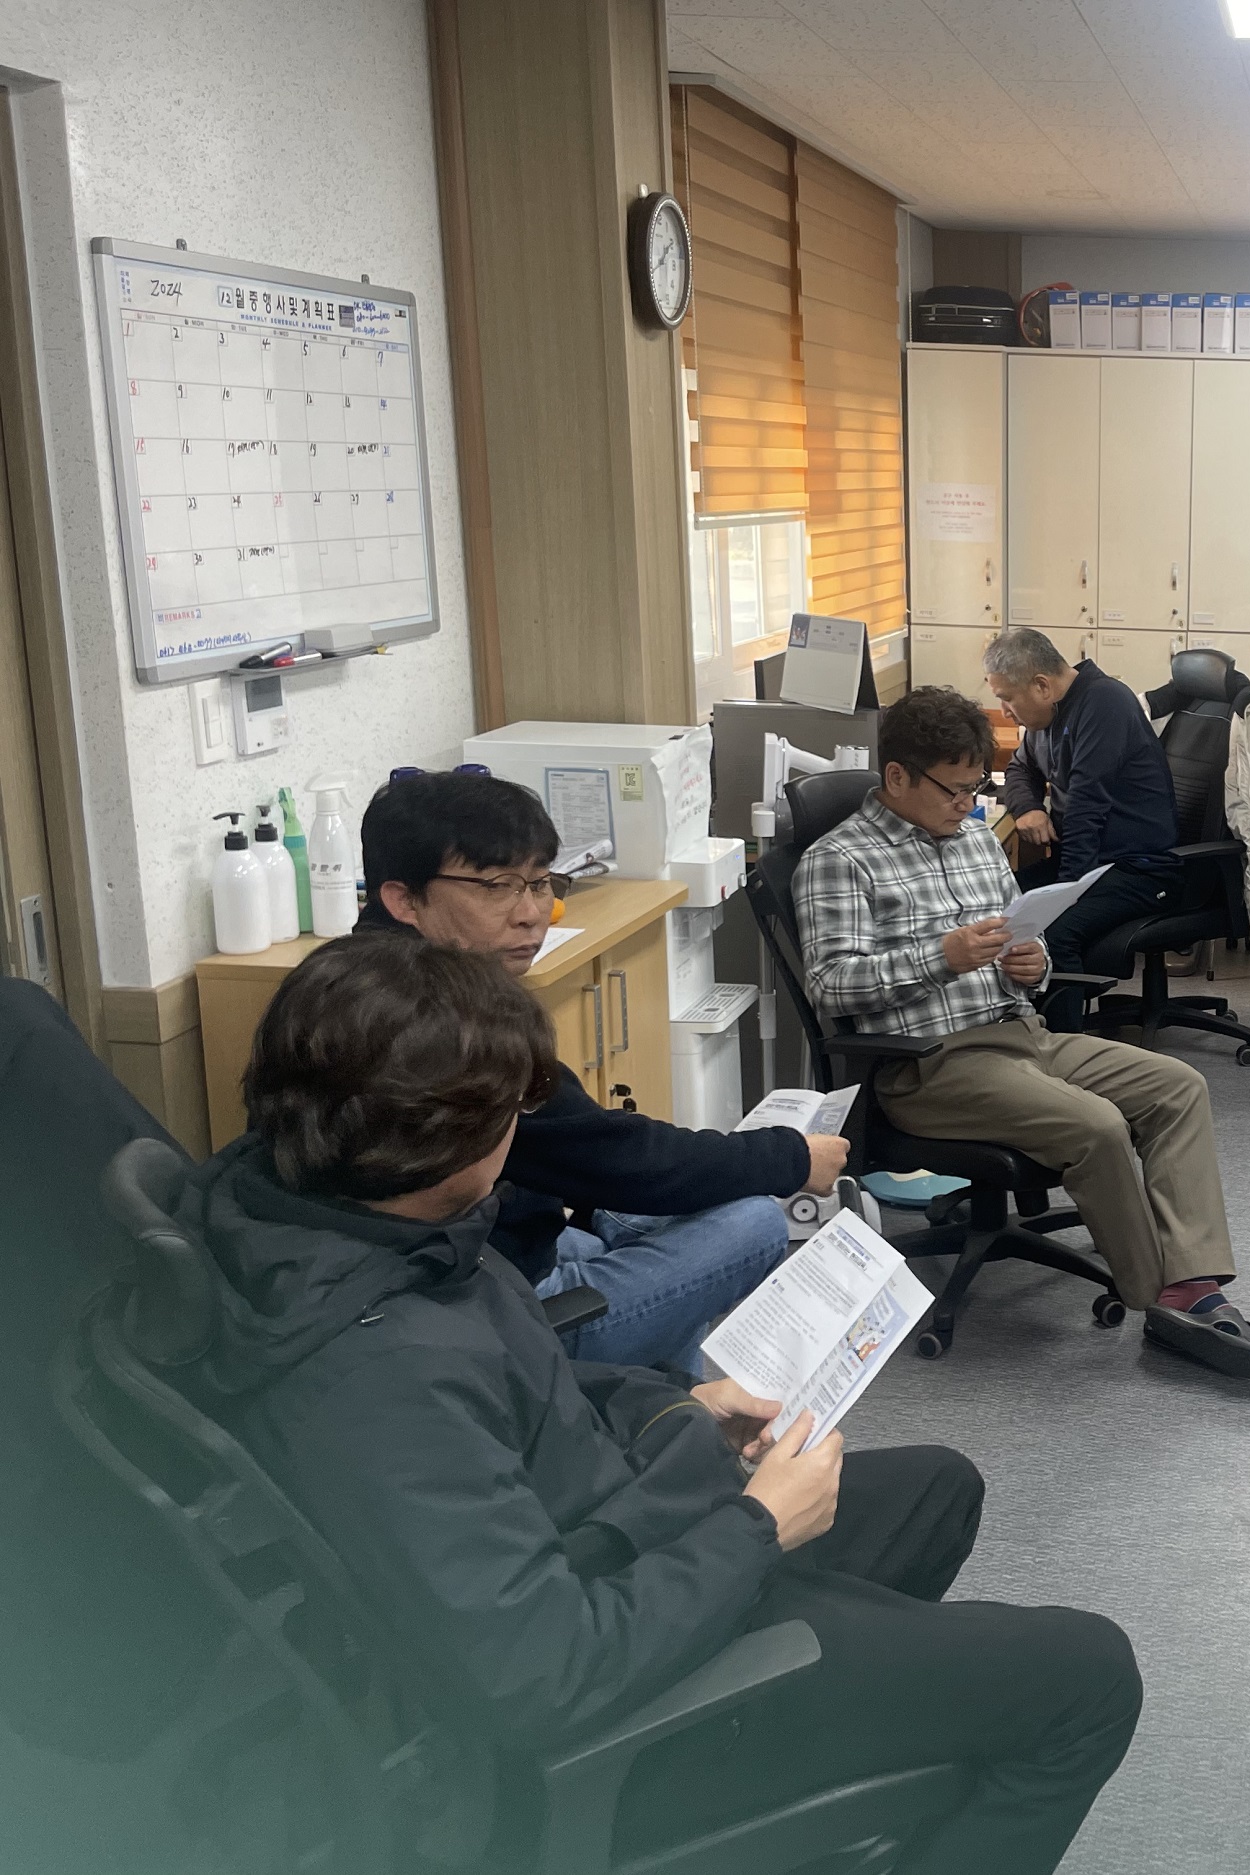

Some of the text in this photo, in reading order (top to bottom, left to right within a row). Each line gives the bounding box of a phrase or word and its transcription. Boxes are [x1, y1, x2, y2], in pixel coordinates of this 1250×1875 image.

[150, 279, 182, 306] 2024
[240, 314, 267, 323] MONTHLY
[270, 318, 299, 327] SCHEDULE
[308, 323, 332, 332] PLANNER
[262, 339, 270, 349] 4
[222, 387, 230, 400] 10
[266, 388, 273, 400] 11
[182, 439, 190, 454] 16
[270, 440, 278, 455] 18
[310, 442, 316, 457] 19
[188, 497, 197, 509] 23
[194, 553, 202, 565] 30
[238, 548, 245, 561] 31
[165, 610, 195, 621] REMARKS
